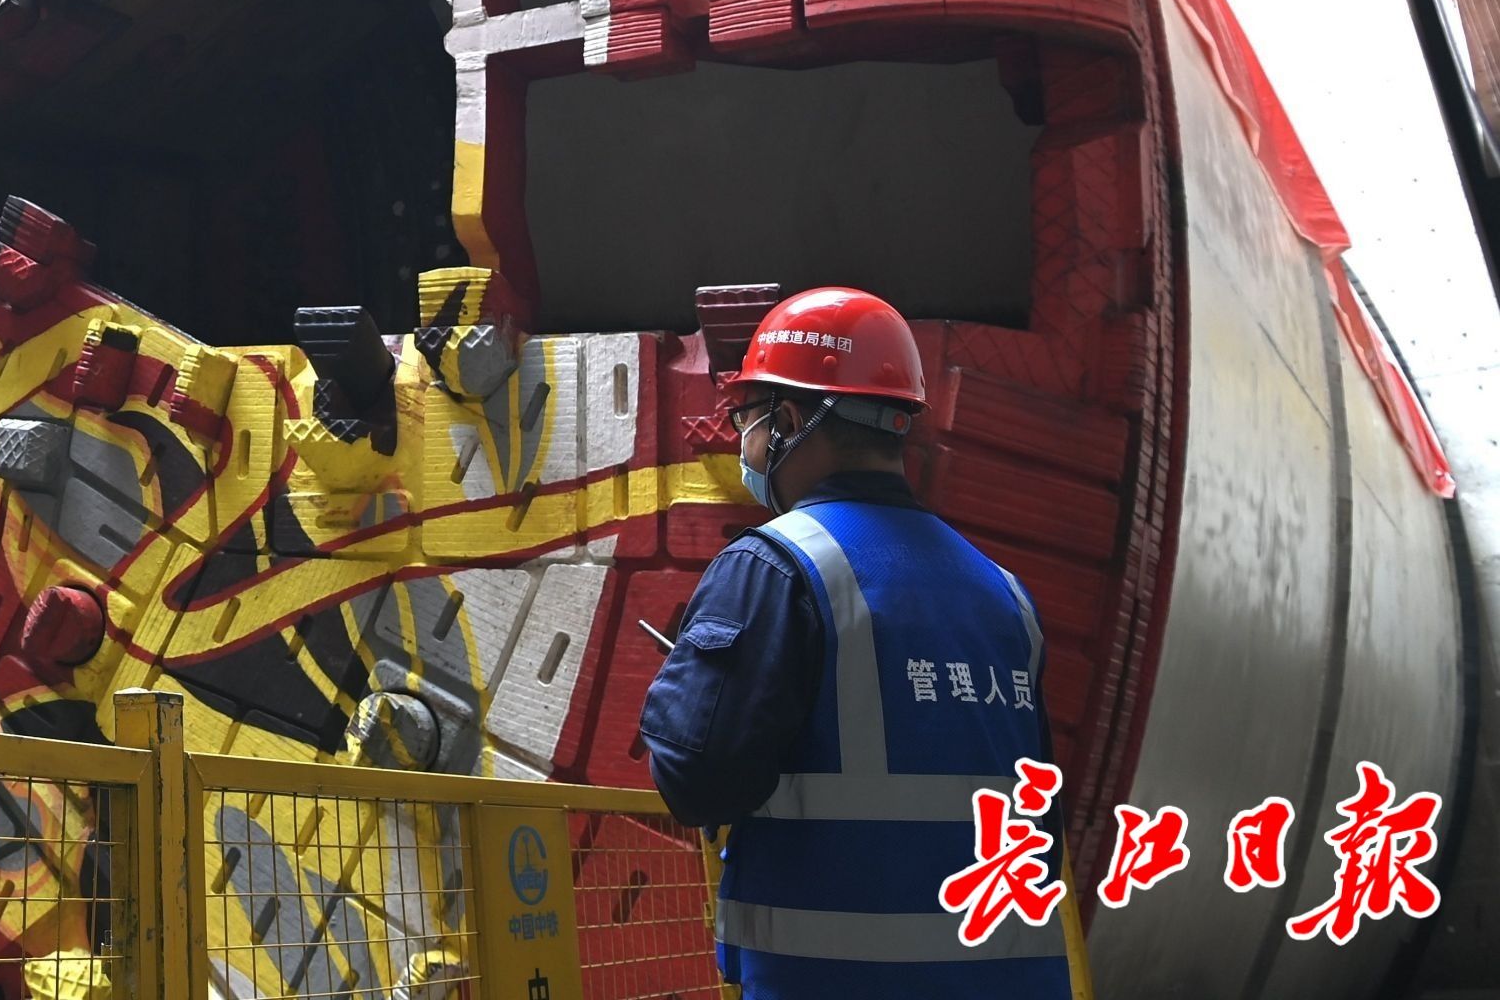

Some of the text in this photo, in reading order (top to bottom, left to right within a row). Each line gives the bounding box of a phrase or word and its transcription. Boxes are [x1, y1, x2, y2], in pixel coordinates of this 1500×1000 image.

[757, 329, 853, 354] 中铁隧道局集团
[906, 658, 1034, 712] 管理人员
